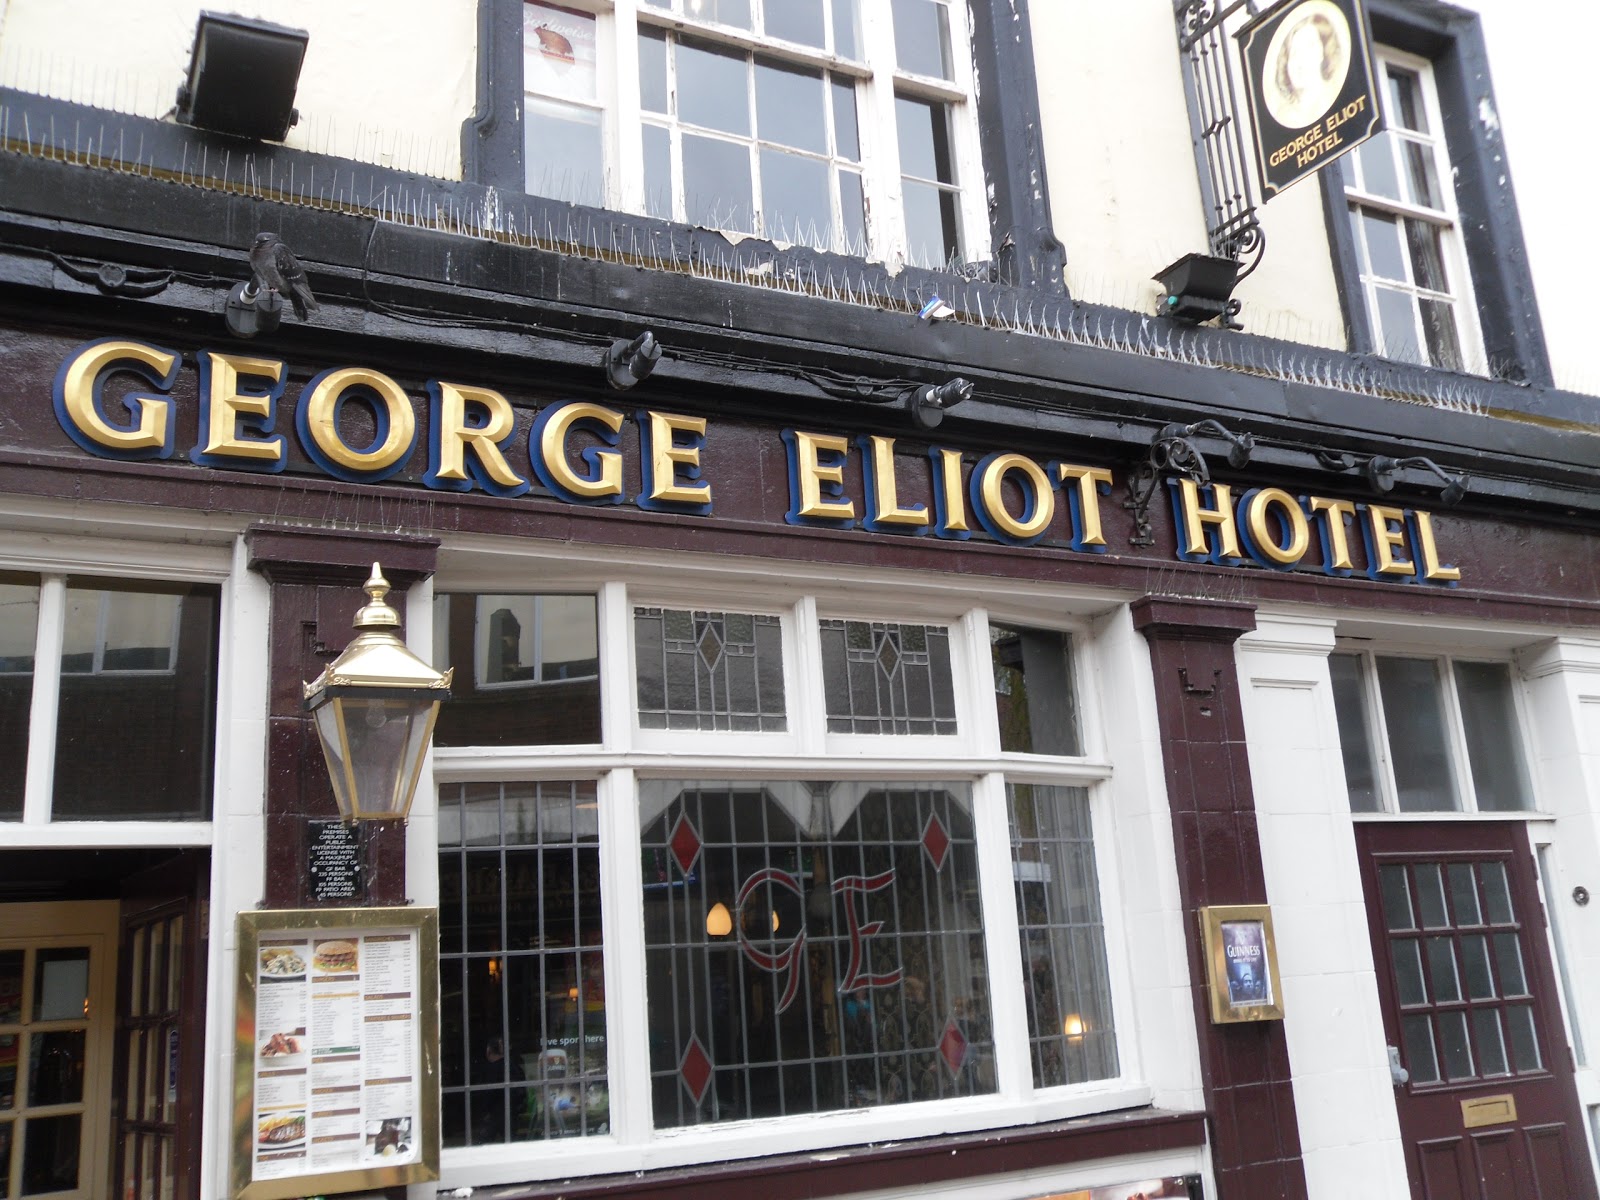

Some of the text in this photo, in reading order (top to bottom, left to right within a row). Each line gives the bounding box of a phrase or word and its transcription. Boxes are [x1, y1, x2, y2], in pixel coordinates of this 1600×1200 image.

[523, 9, 595, 41] Budweise
[1269, 95, 1366, 167] GEORGE ELIOT
[1297, 131, 1343, 168] HOTEL
[60, 338, 1462, 583] GEORGE ELIOT HOTEL
[1227, 944, 1261, 957] GUINNESS
[540, 1034, 604, 1046] Lve spor here
